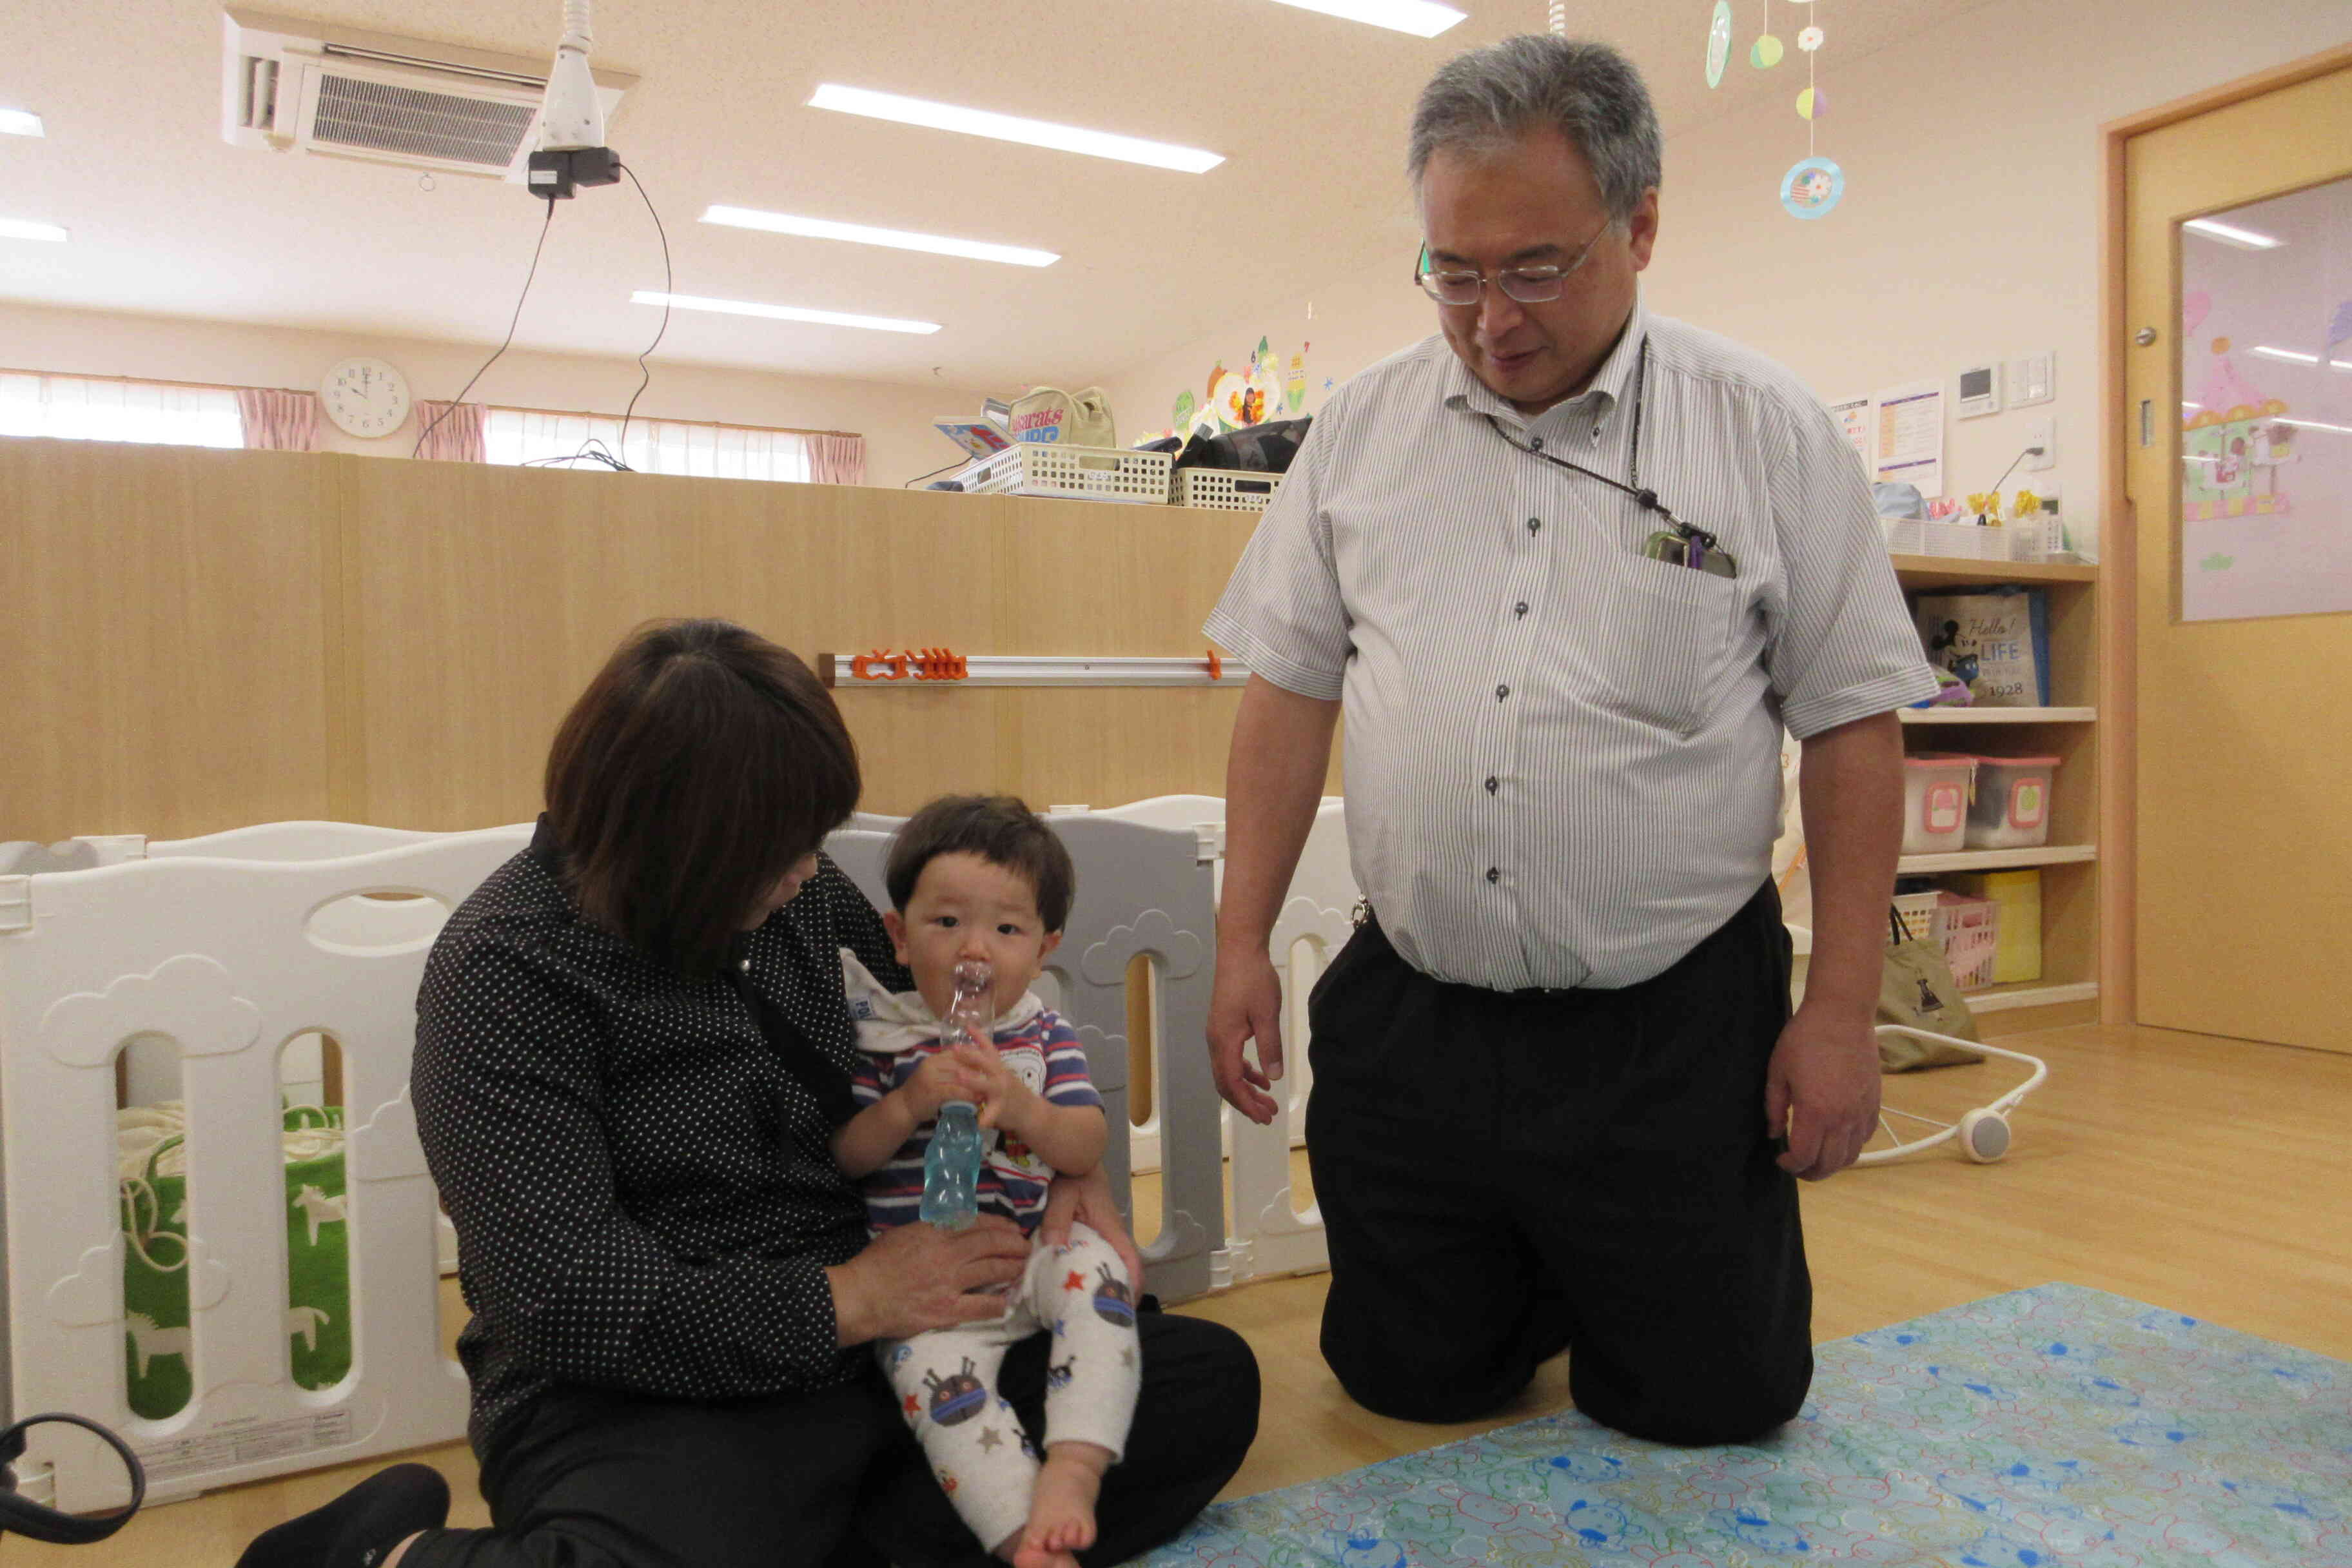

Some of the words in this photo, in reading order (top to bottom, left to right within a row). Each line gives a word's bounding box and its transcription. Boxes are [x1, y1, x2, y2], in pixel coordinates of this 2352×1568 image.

[1969, 617, 2016, 636] Hello!
[1981, 642, 2021, 660] LIFE
[1990, 682, 2023, 696] 1928
